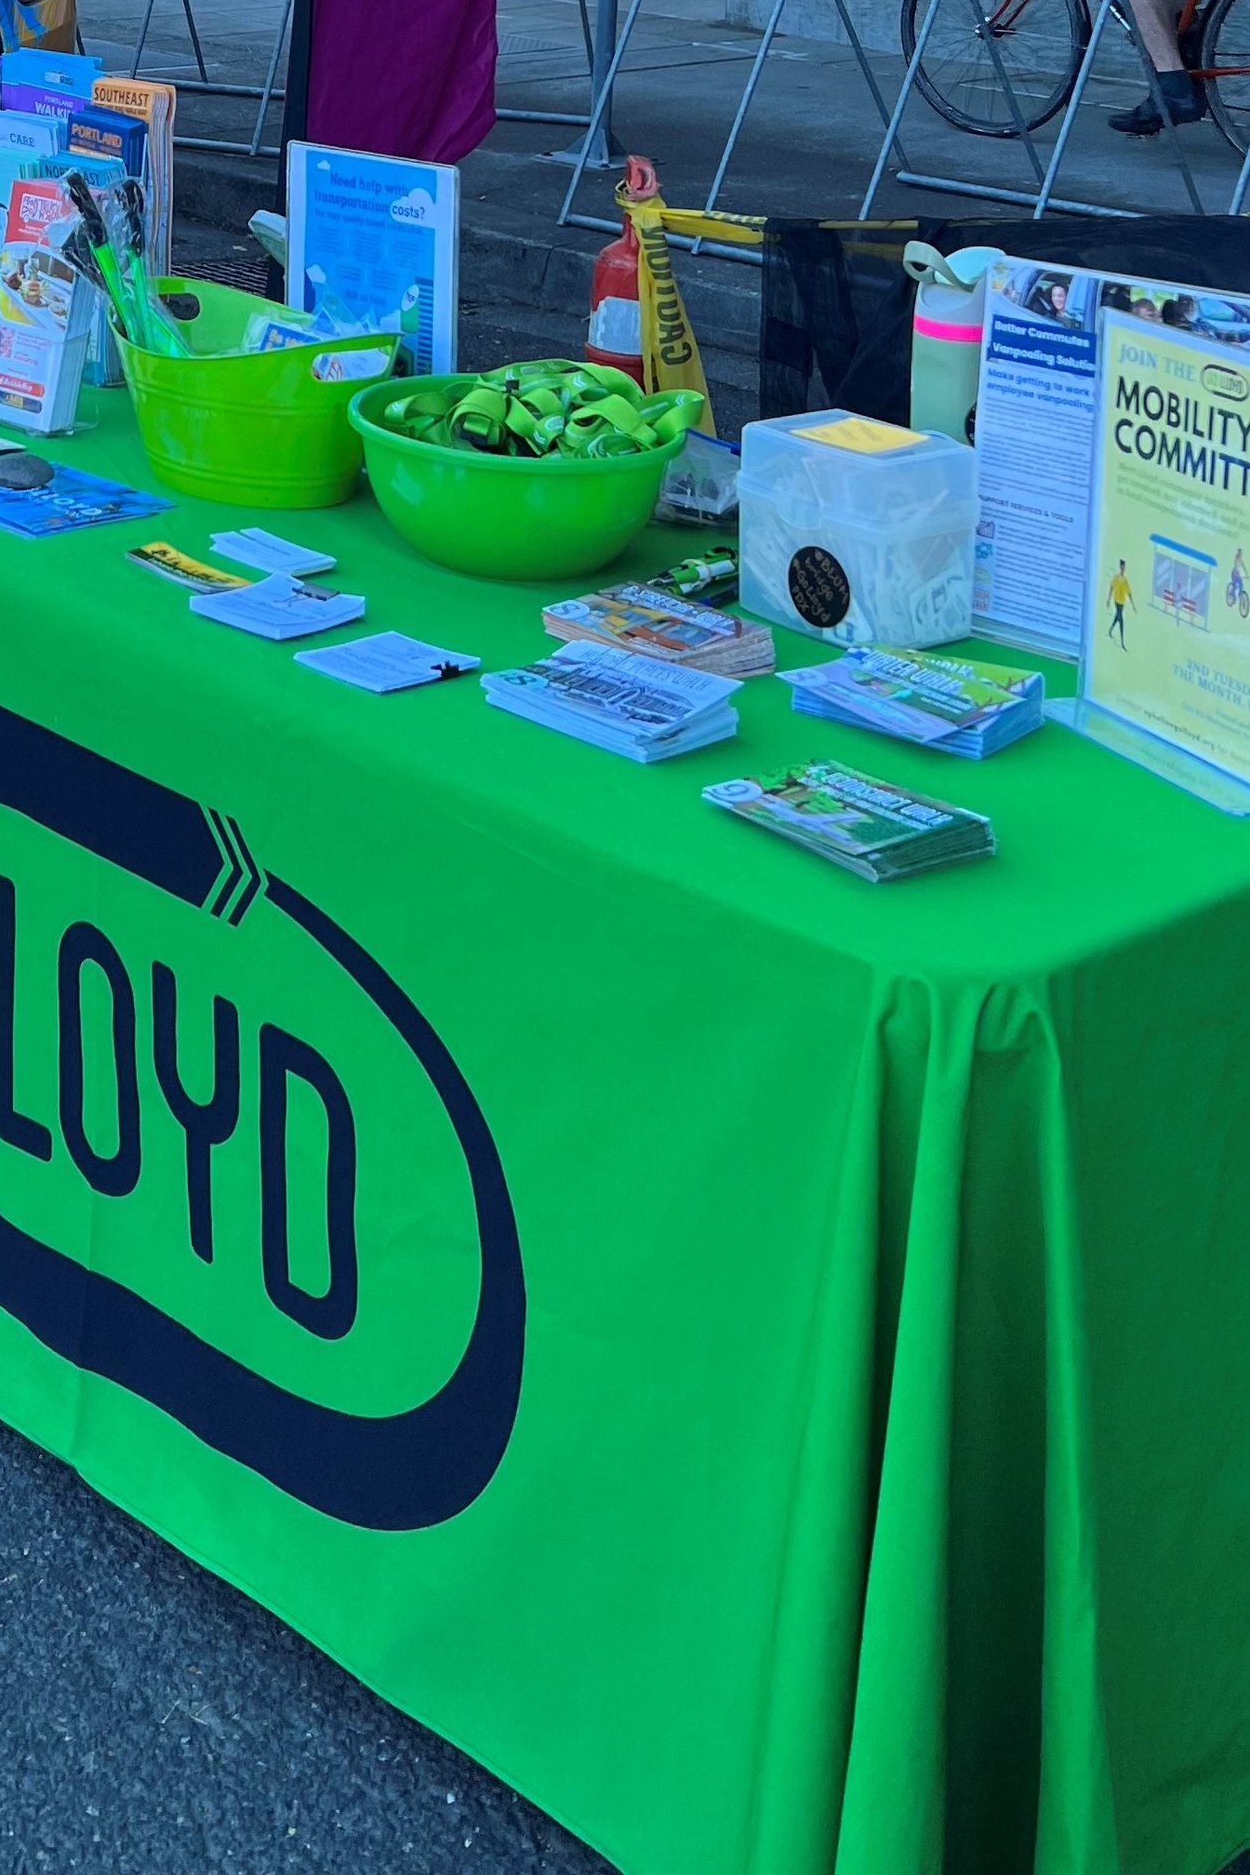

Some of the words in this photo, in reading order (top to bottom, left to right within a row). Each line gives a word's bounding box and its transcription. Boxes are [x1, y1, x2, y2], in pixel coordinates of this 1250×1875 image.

[94, 87, 150, 108] SOUTHEAST
[10, 133, 35, 148] CARE
[71, 123, 123, 148] PORTLAND
[330, 173, 356, 188] Need
[359, 178, 381, 195] help
[385, 185, 409, 197] with
[315, 189, 389, 213] transportation
[392, 205, 425, 220] costs?
[994, 320, 1027, 336] Better
[1028, 327, 1090, 348] Commutes
[993, 342, 1056, 366] Vanpooling
[1118, 343, 1158, 369] JOIN
[1164, 357, 1196, 381] THE
[987, 383, 1035, 398] employee
[988, 368, 1014, 381] Make
[1015, 374, 1050, 391] getting
[1053, 380, 1063, 390] to
[1066, 384, 1090, 396] work
[1116, 375, 1250, 453] MOBILITY
[637, 660, 672, 682] PLACES
[1172, 663, 1194, 683] THE
[1187, 658, 1210, 677] 2ND
